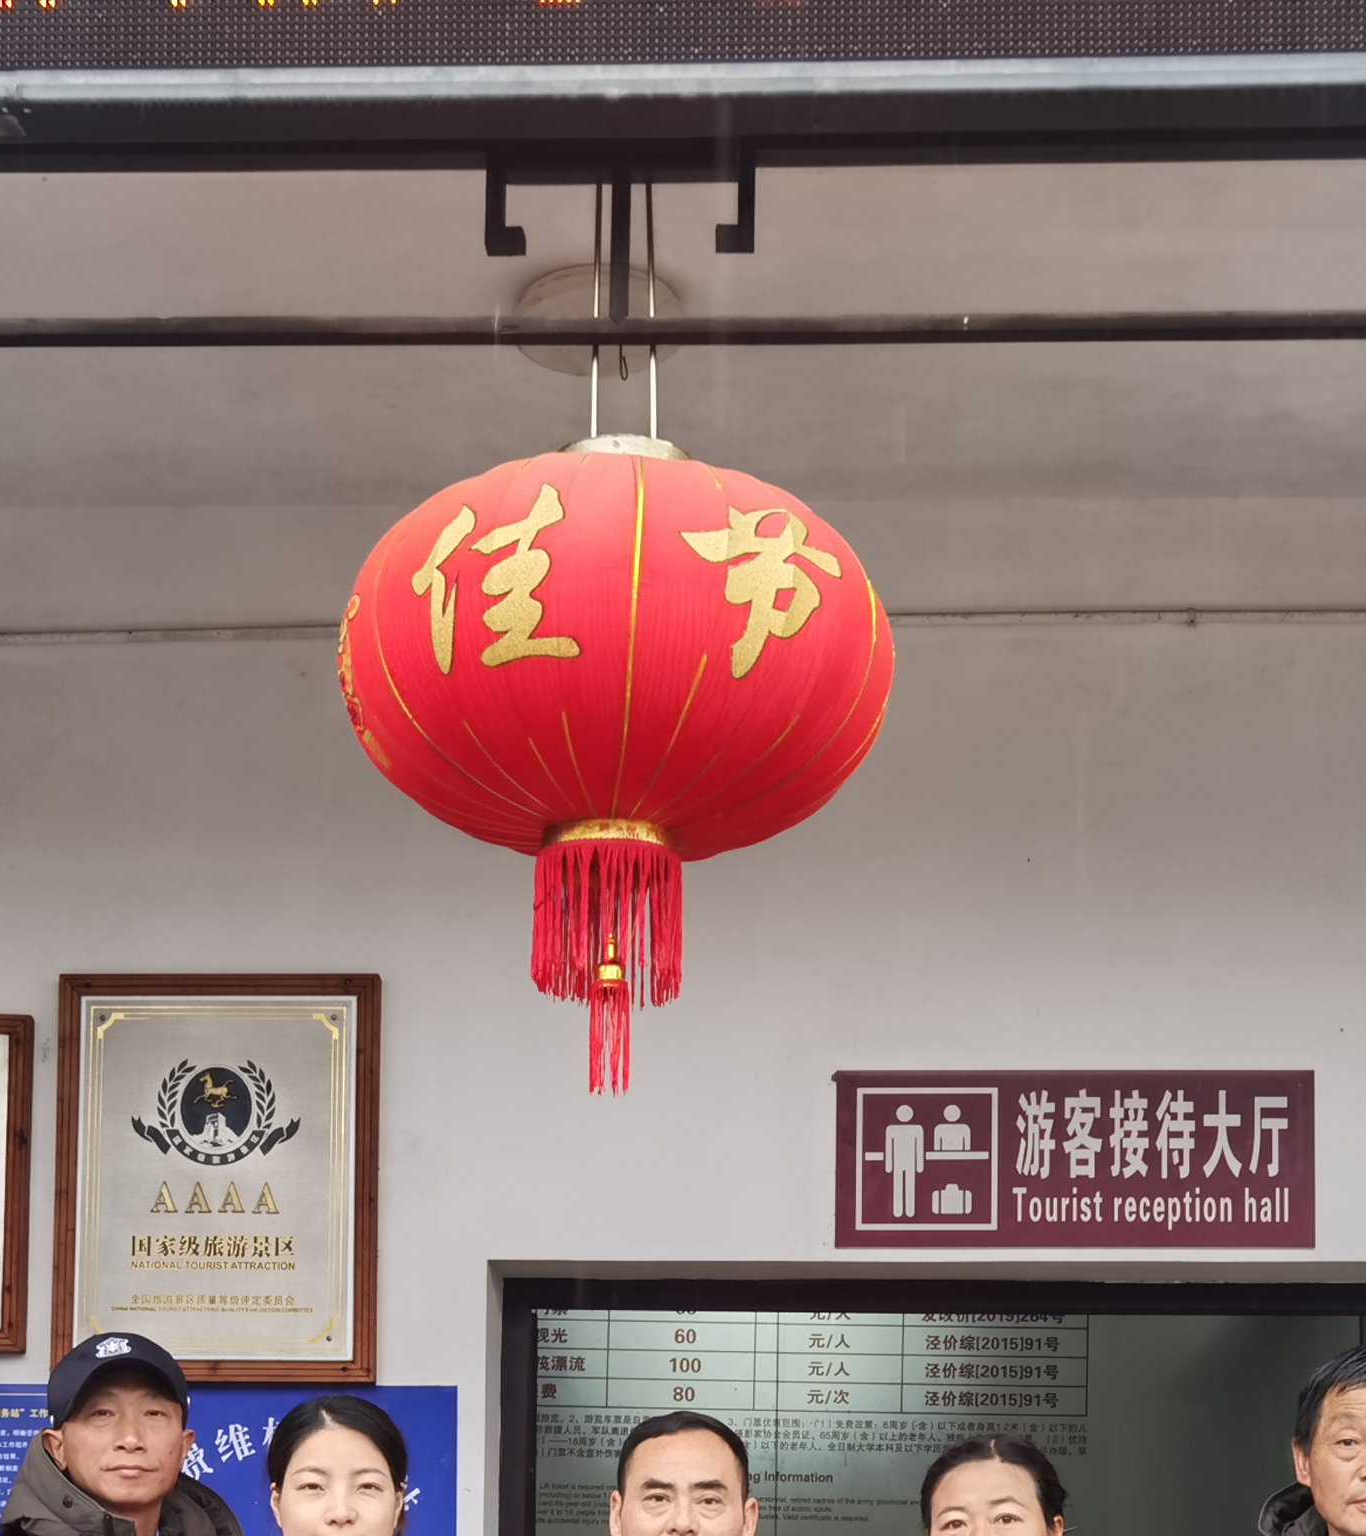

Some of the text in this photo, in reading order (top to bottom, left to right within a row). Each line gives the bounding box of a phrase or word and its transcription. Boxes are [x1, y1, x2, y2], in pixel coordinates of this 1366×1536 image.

[1015, 1088, 1289, 1180] 游客接待大厅
[1013, 1187, 1289, 1230] Tourist reception hall
[131, 1234, 295, 1258] 国家级旅游景区
[131, 1261, 296, 1271] NATIONAL TOURIST ATTRACTION
[674, 1329, 697, 1345] 60
[808, 1334, 851, 1349] 元/人
[925, 1335, 1060, 1352] 泾价综[2015]91号
[669, 1358, 702, 1373] 100
[808, 1362, 850, 1377] 元/人
[925, 1363, 1059, 1380] 泾价综[2015]91号
[536, 1383, 1059, 1409] 费 80 元/次 泾价综[2015]91号
[765, 1471, 833, 1483] Information
